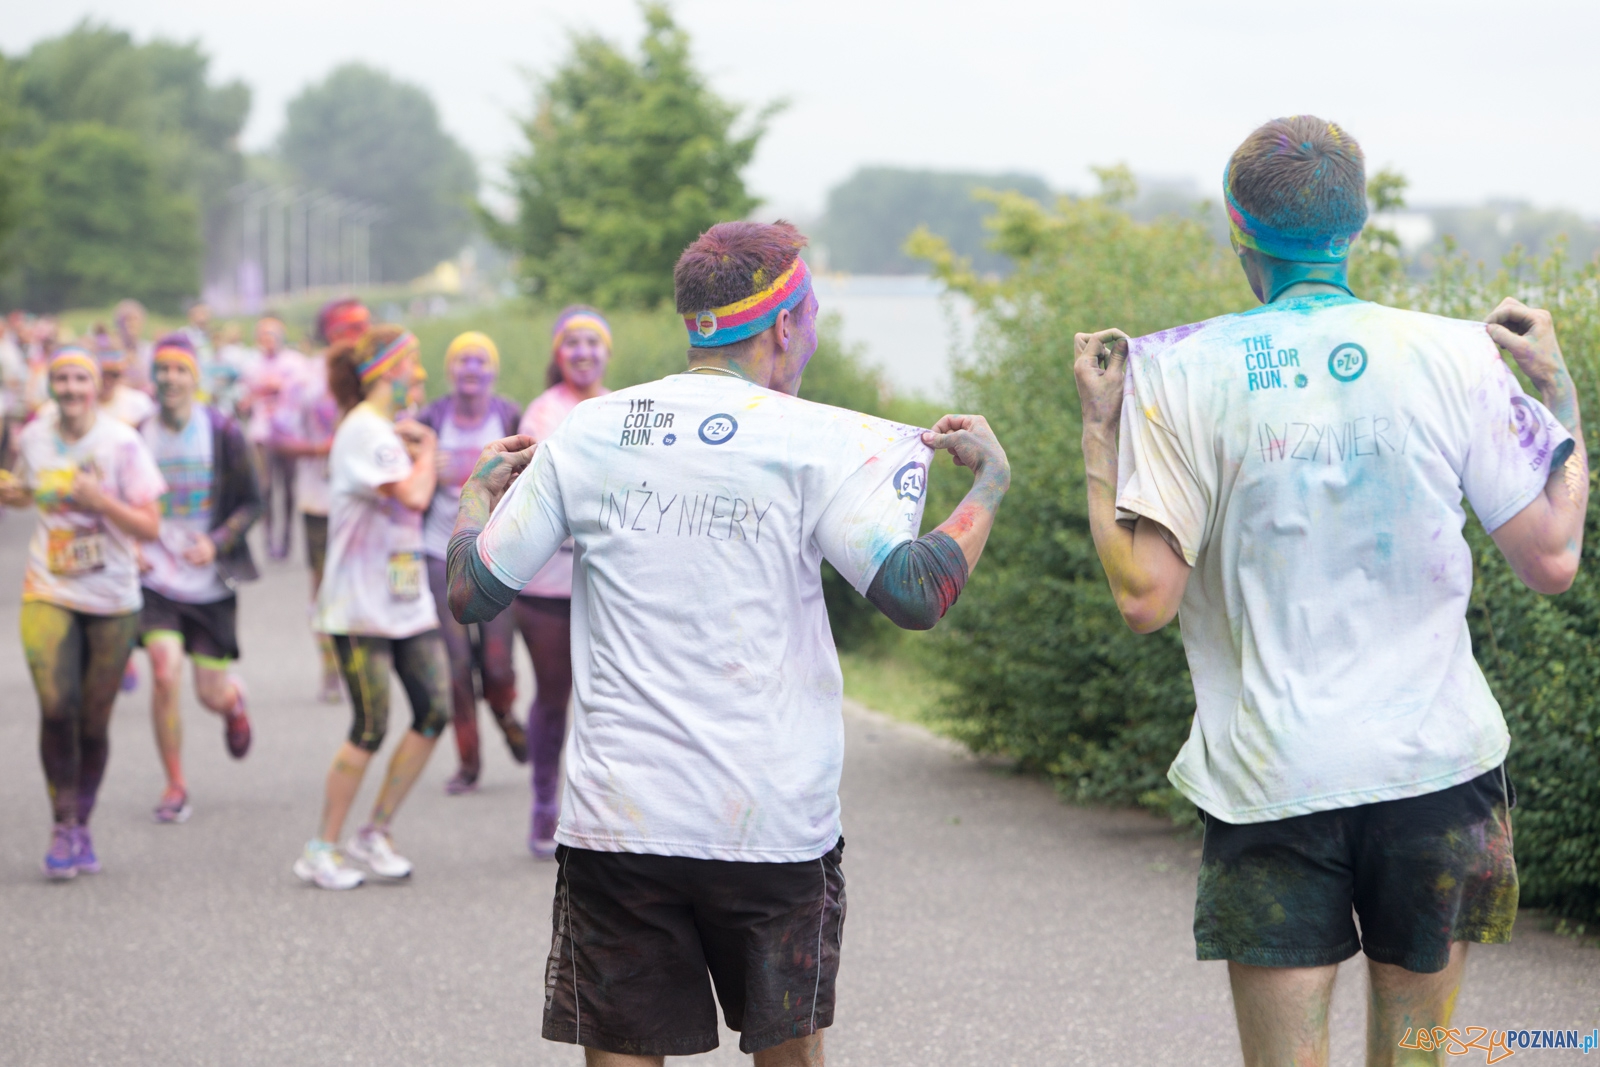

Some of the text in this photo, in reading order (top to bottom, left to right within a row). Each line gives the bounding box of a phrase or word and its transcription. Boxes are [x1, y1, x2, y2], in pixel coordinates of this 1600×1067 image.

[1243, 335, 1274, 353] THE
[1245, 348, 1301, 372] COLOR
[1336, 353, 1360, 371] PZU
[629, 399, 655, 413] THE
[623, 412, 675, 429] COLOR
[706, 422, 730, 435] PZU
[598, 480, 773, 544] INŻYNIERY
